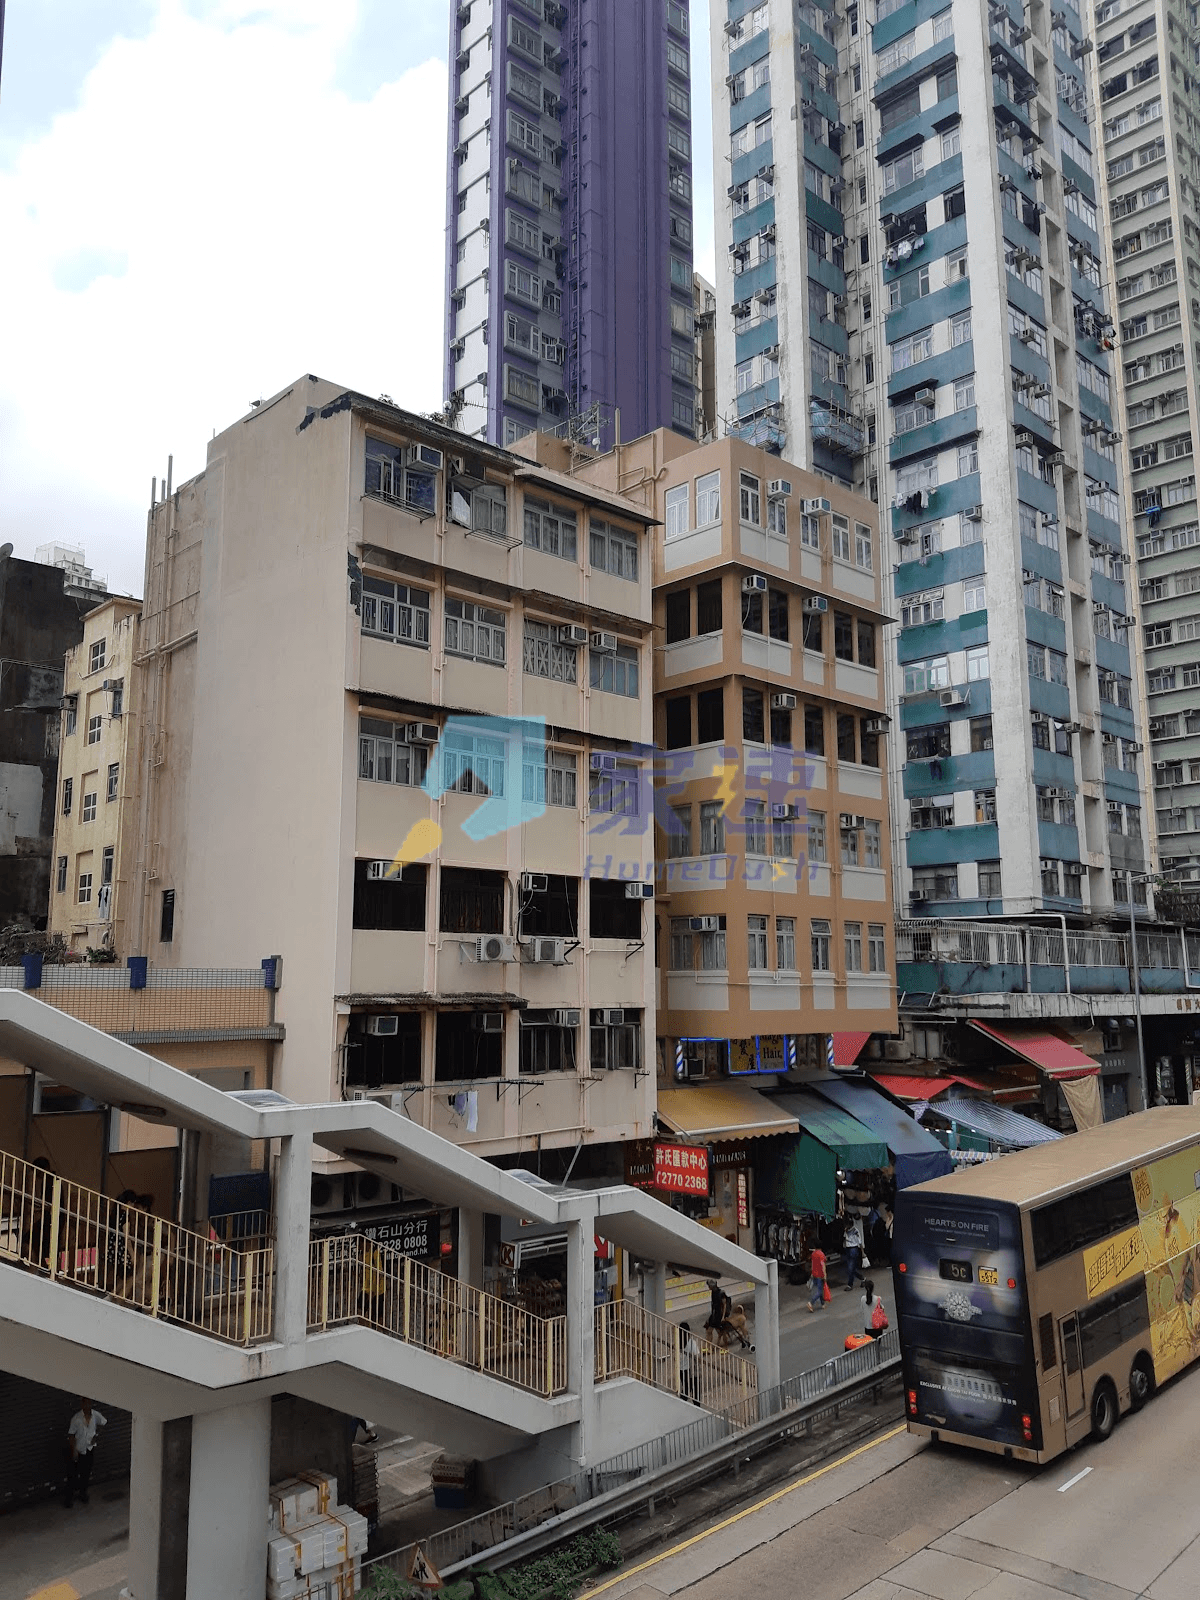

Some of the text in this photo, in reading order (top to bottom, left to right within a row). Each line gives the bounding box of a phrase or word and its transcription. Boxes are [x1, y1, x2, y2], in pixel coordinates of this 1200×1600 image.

[661, 1171, 683, 1188] 2770
[684, 1174, 708, 1190] 2368
[924, 1218, 957, 1229] HEARTS
[957, 1221, 970, 1230] ON
[971, 1223, 990, 1232] FIRE
[403, 1234, 428, 1249] 0808
